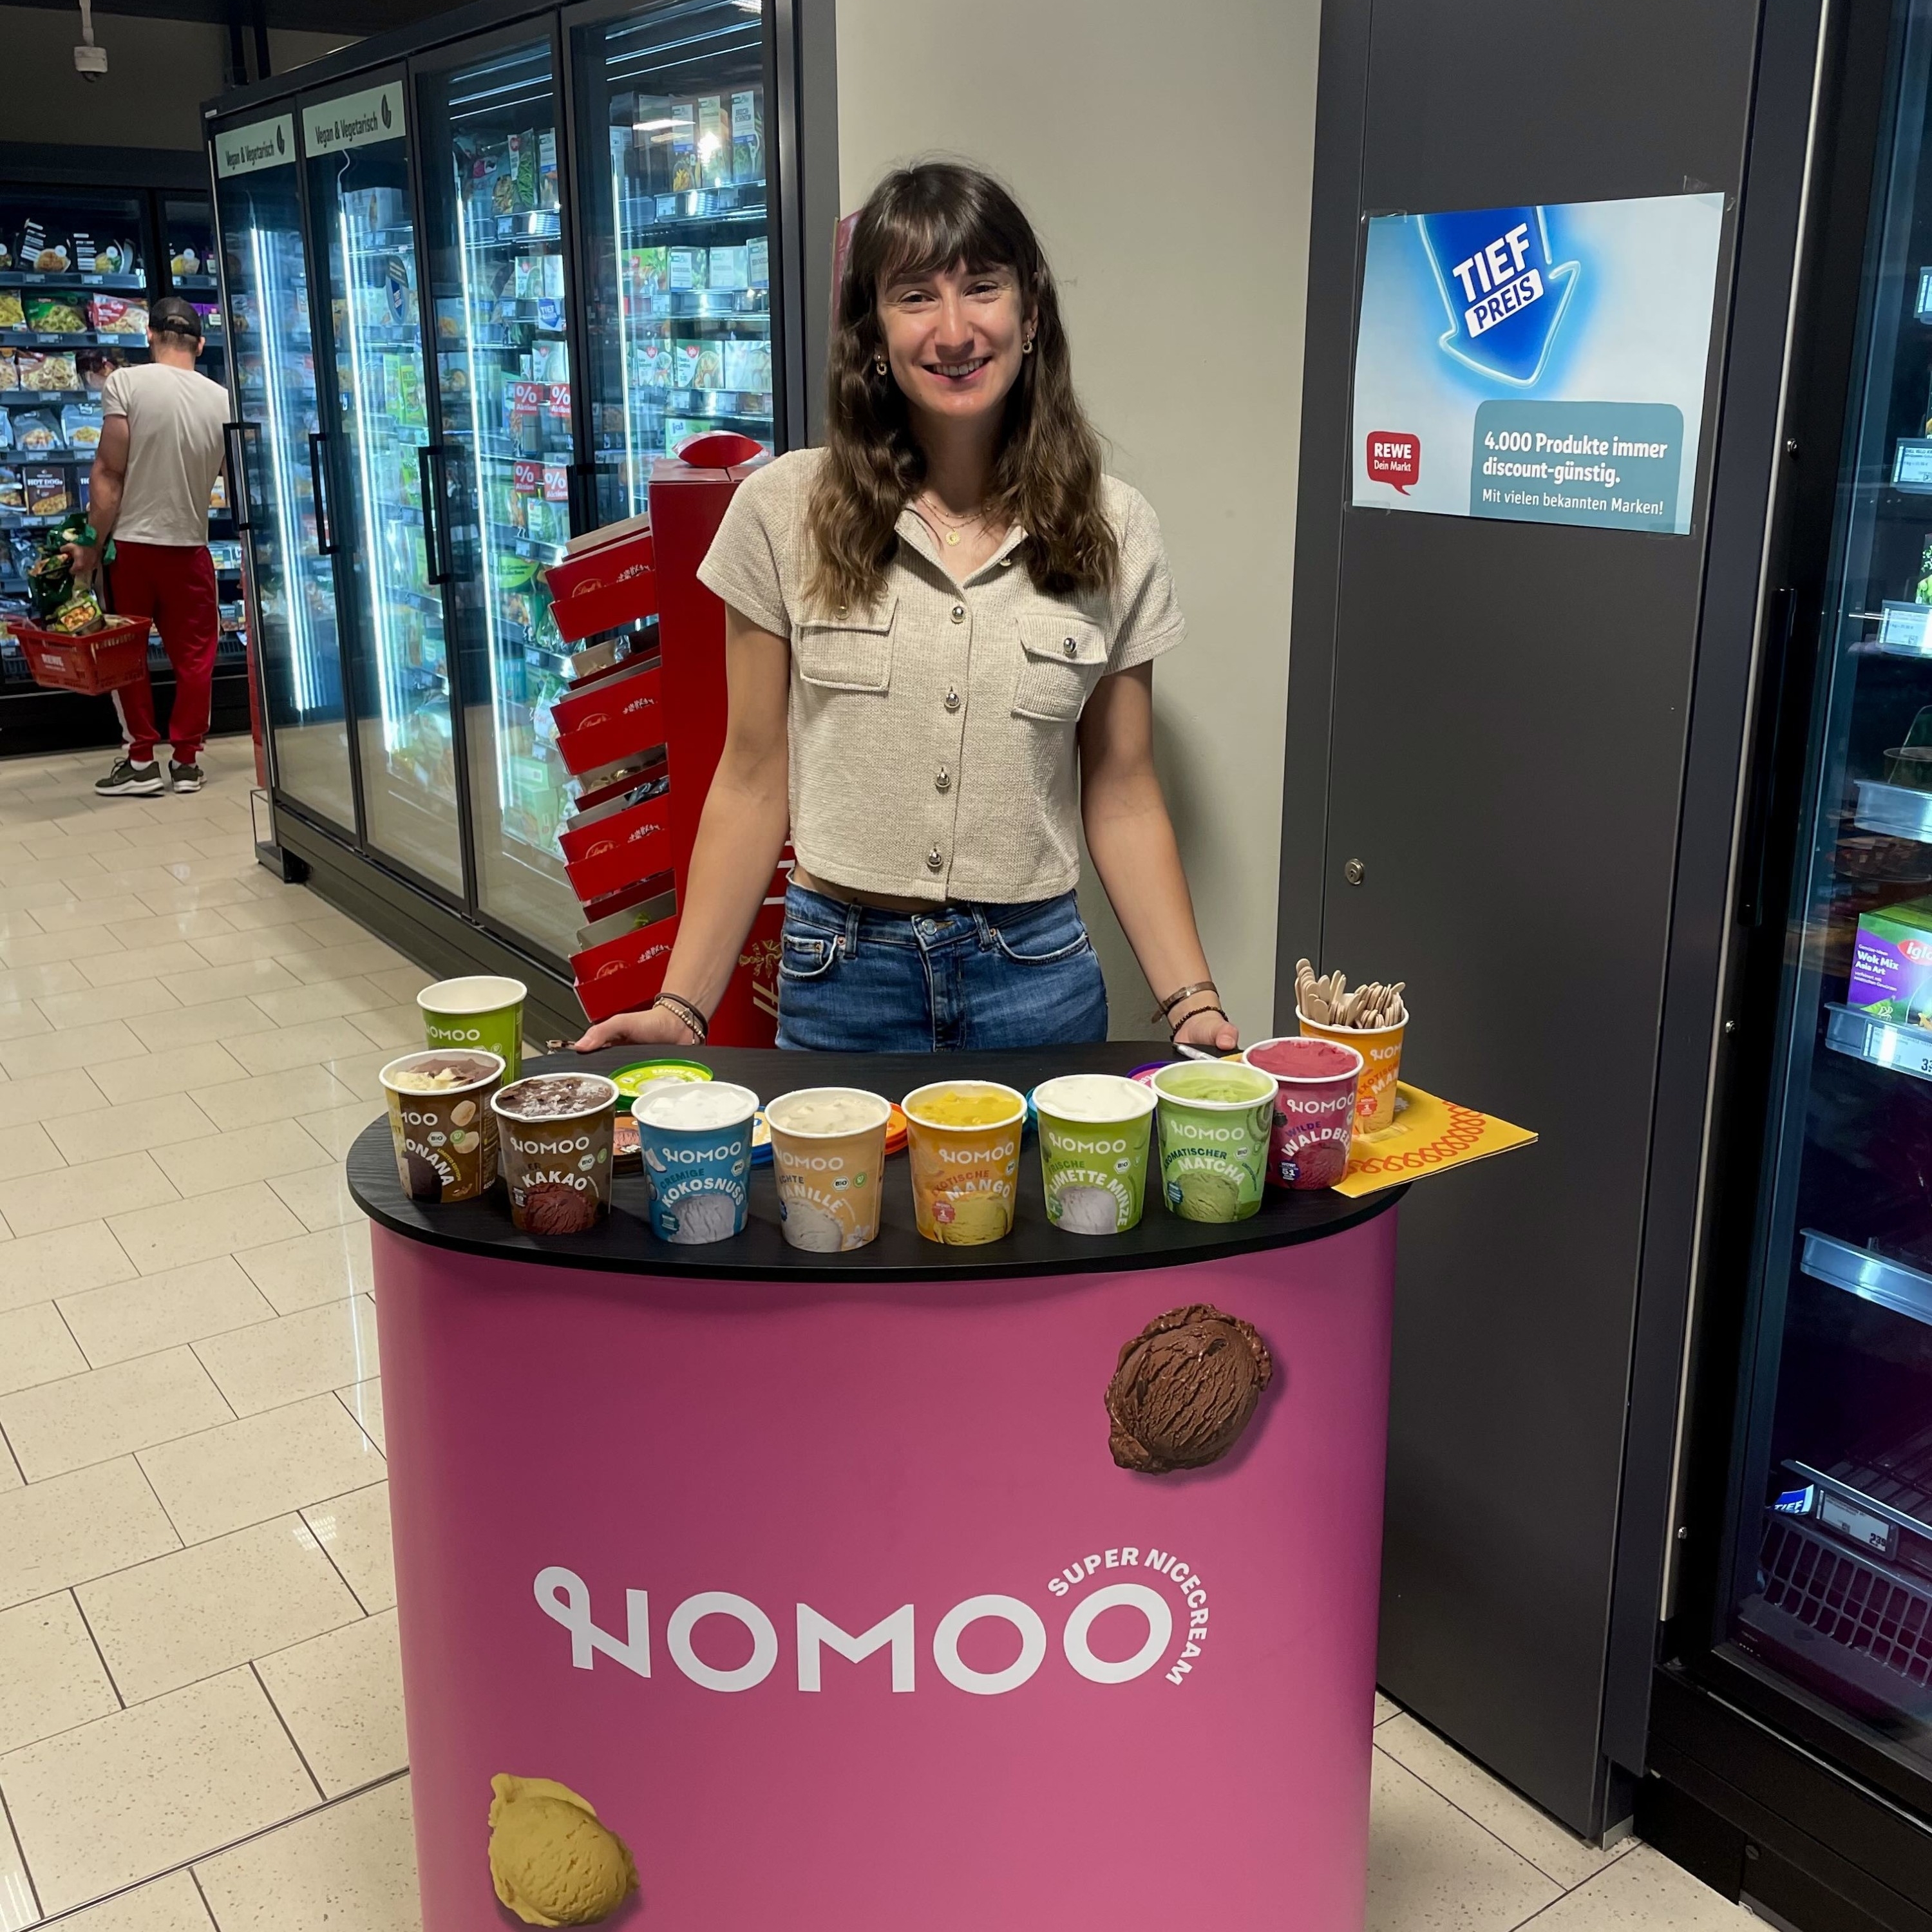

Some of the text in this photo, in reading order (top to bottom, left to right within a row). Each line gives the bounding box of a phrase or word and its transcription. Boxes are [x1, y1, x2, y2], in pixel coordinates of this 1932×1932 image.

[315, 111, 378, 147] Vegan & Vegetarisch
[225, 140, 274, 169] Vegan & Vegetarisch
[1452, 223, 1530, 303] TIEF
[1473, 276, 1534, 330] PREIS
[1374, 442, 1412, 459] REWE
[1484, 431, 1668, 458] 4.000 Produkte immer
[1374, 459, 1411, 472] Dein Markt
[1483, 457, 1620, 488] discount-günstig.
[1483, 488, 1663, 515] Mit vielen bekannten Marken!
[1855, 961, 1886, 976] Asia Art
[1857, 950, 1899, 971] Wok Mix
[1287, 1092, 1354, 1113] NOMOO
[1171, 1119, 1245, 1141] NOMOO
[1286, 1121, 1321, 1137] WILDE
[510, 1137, 589, 1154] NOMOO
[662, 1141, 741, 1164] NOMOO
[939, 1142, 1014, 1164] NOMOO
[1048, 1132, 1126, 1154] NOMOO
[522, 1171, 587, 1191] KAKAO
[660, 1168, 705, 1189] CREMIGE
[1177, 1157, 1245, 1186] MATCHA
[661, 1178, 744, 1208] KOKOSNUSS
[946, 1179, 1010, 1201] MANGO
[1049, 1170, 1108, 1194] LIMETTE
[1106, 1179, 1130, 1226] MINZE
[1048, 1547, 1209, 1685] SUPER NICECREAM
[533, 1566, 1172, 1695] NOMOO
